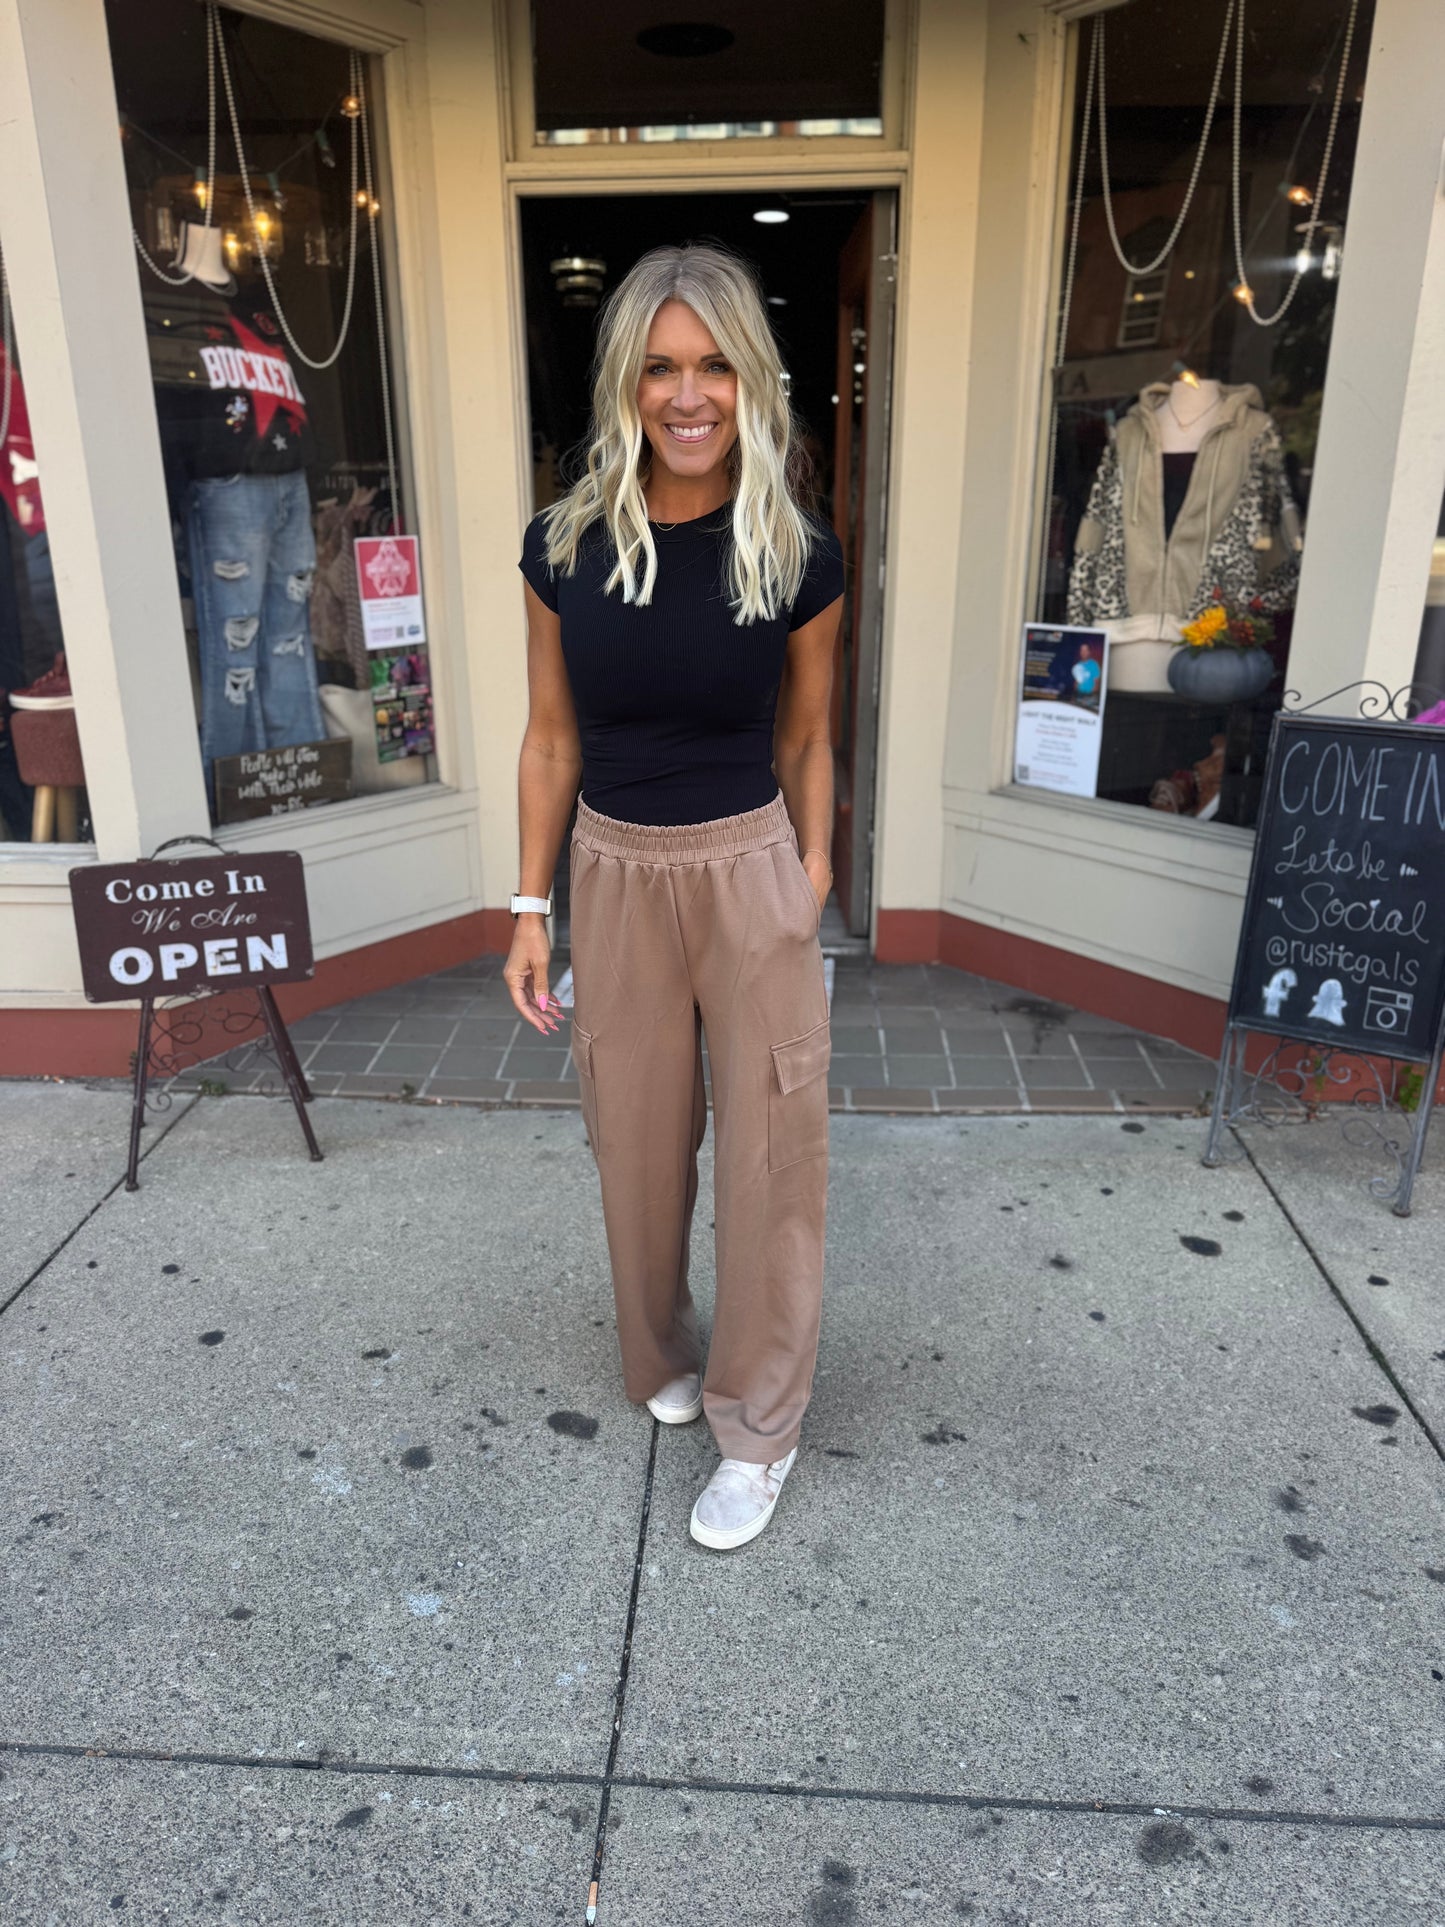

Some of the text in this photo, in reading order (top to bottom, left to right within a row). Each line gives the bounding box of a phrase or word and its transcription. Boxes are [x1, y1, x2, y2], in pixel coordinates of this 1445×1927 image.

[1279, 741, 1394, 821] COME
[1274, 825, 1390, 881] Lets be
[105, 869, 267, 904] Come In
[131, 902, 258, 936] We Are
[1281, 882, 1429, 944] Social
[109, 933, 289, 985] OPEN
[1265, 935, 1420, 987] @rusticgals
